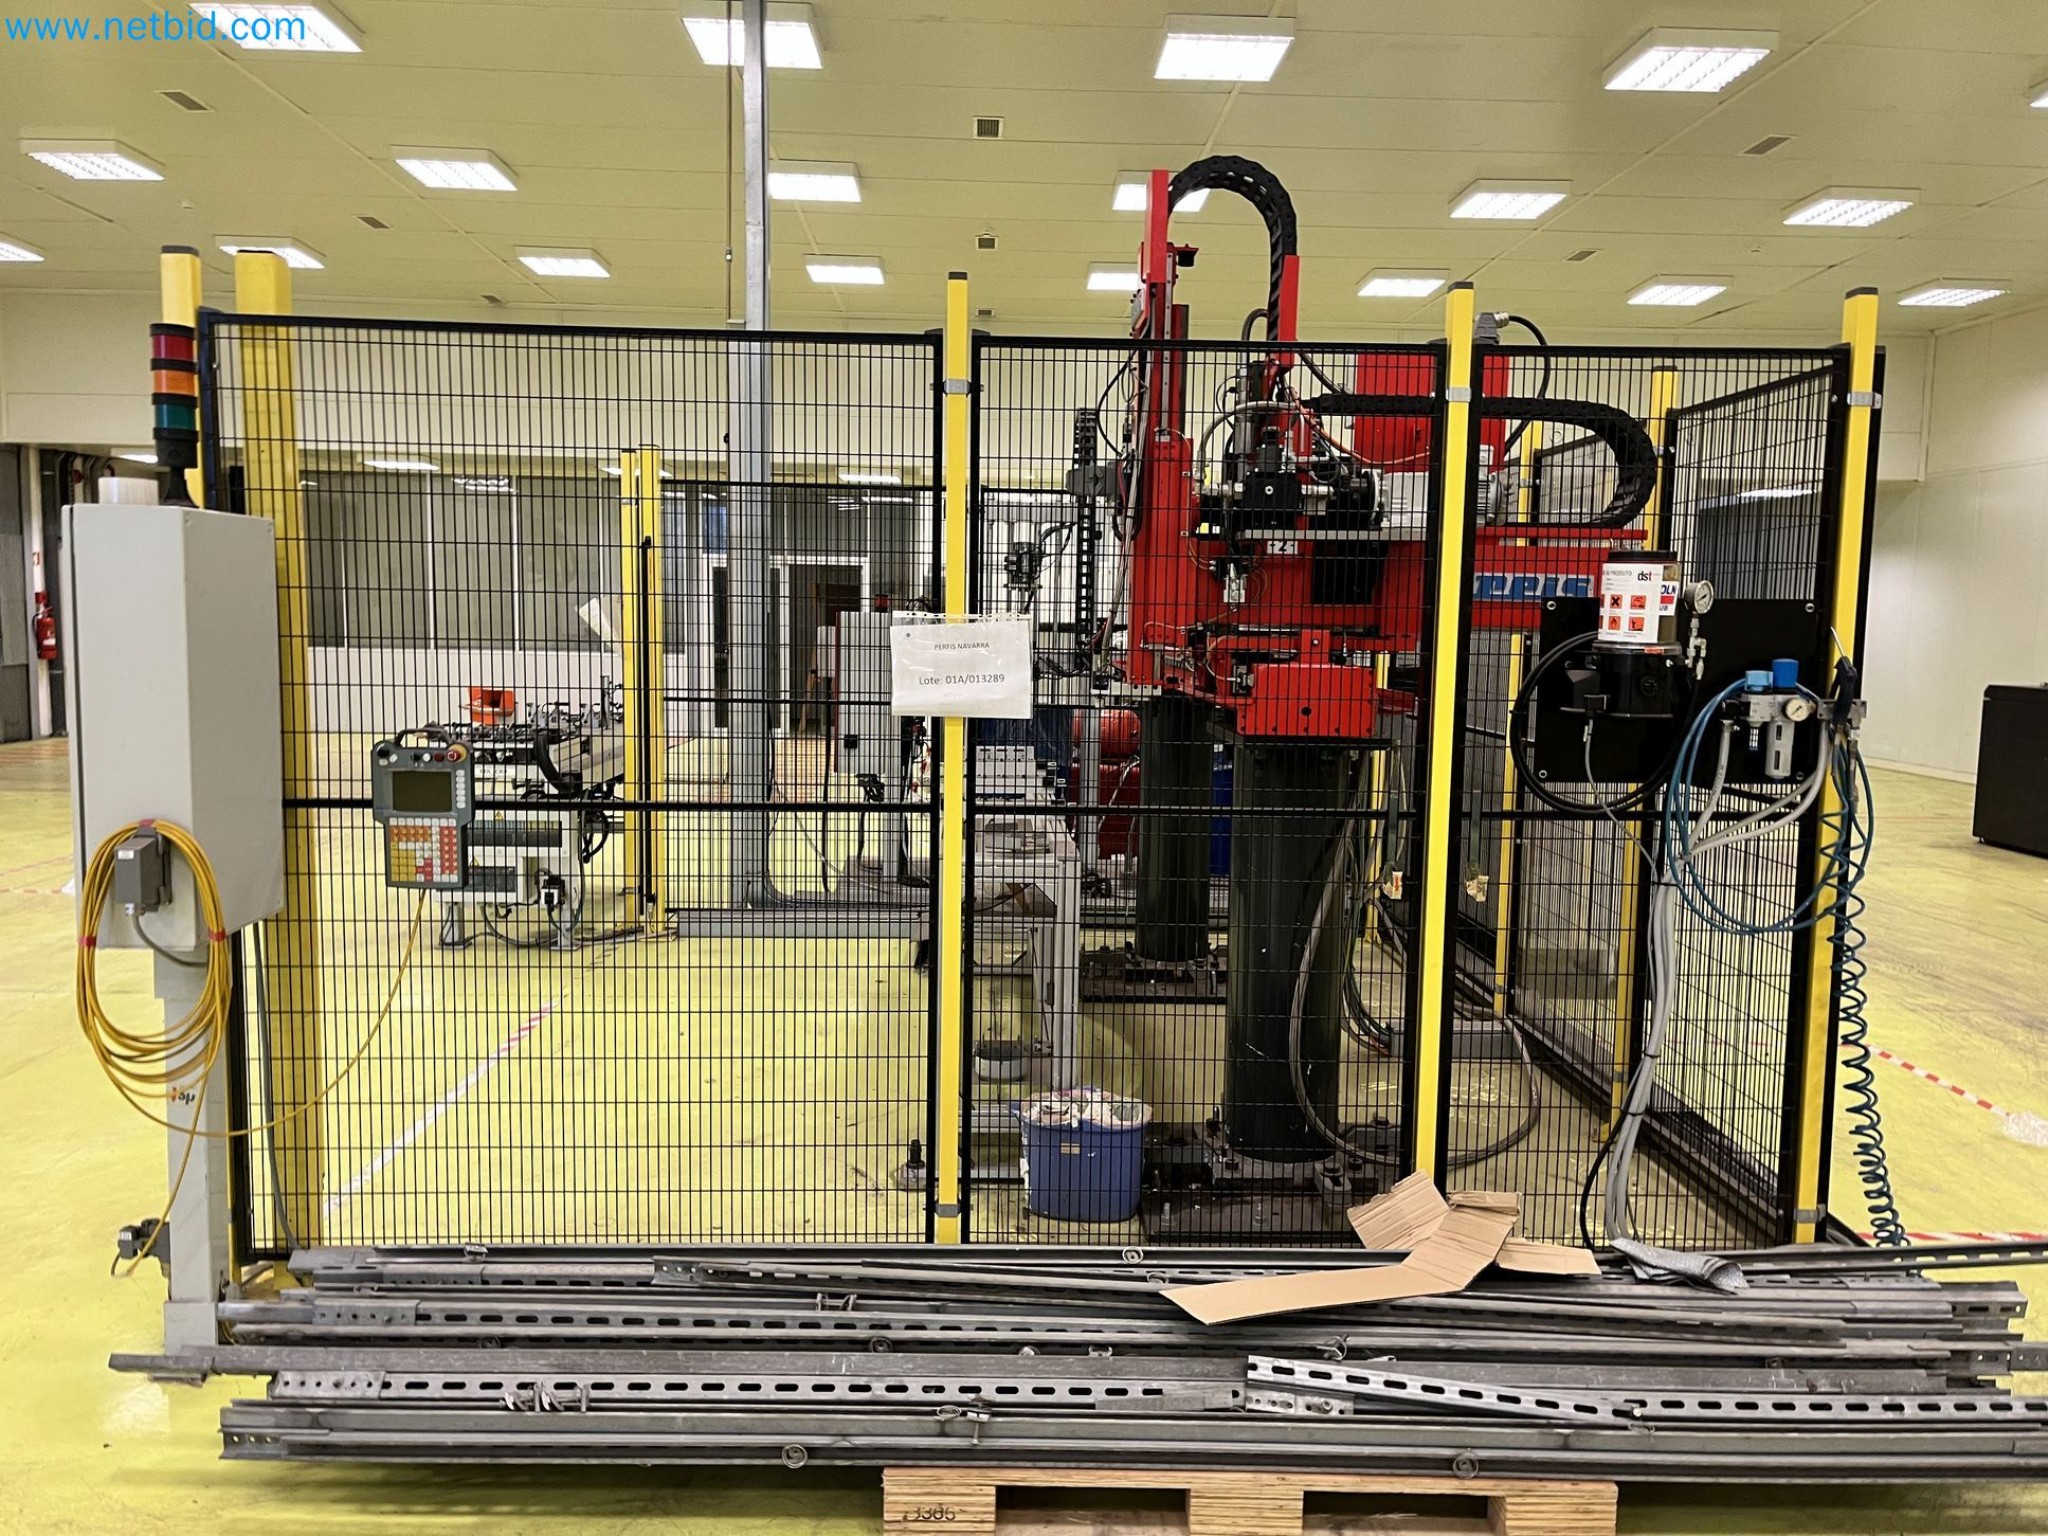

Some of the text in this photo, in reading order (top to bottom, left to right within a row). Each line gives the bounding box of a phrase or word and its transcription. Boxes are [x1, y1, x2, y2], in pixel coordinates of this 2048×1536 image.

[957, 642, 990, 650] NAVARRA
[919, 674, 1005, 685] Lote: 01A/013289
